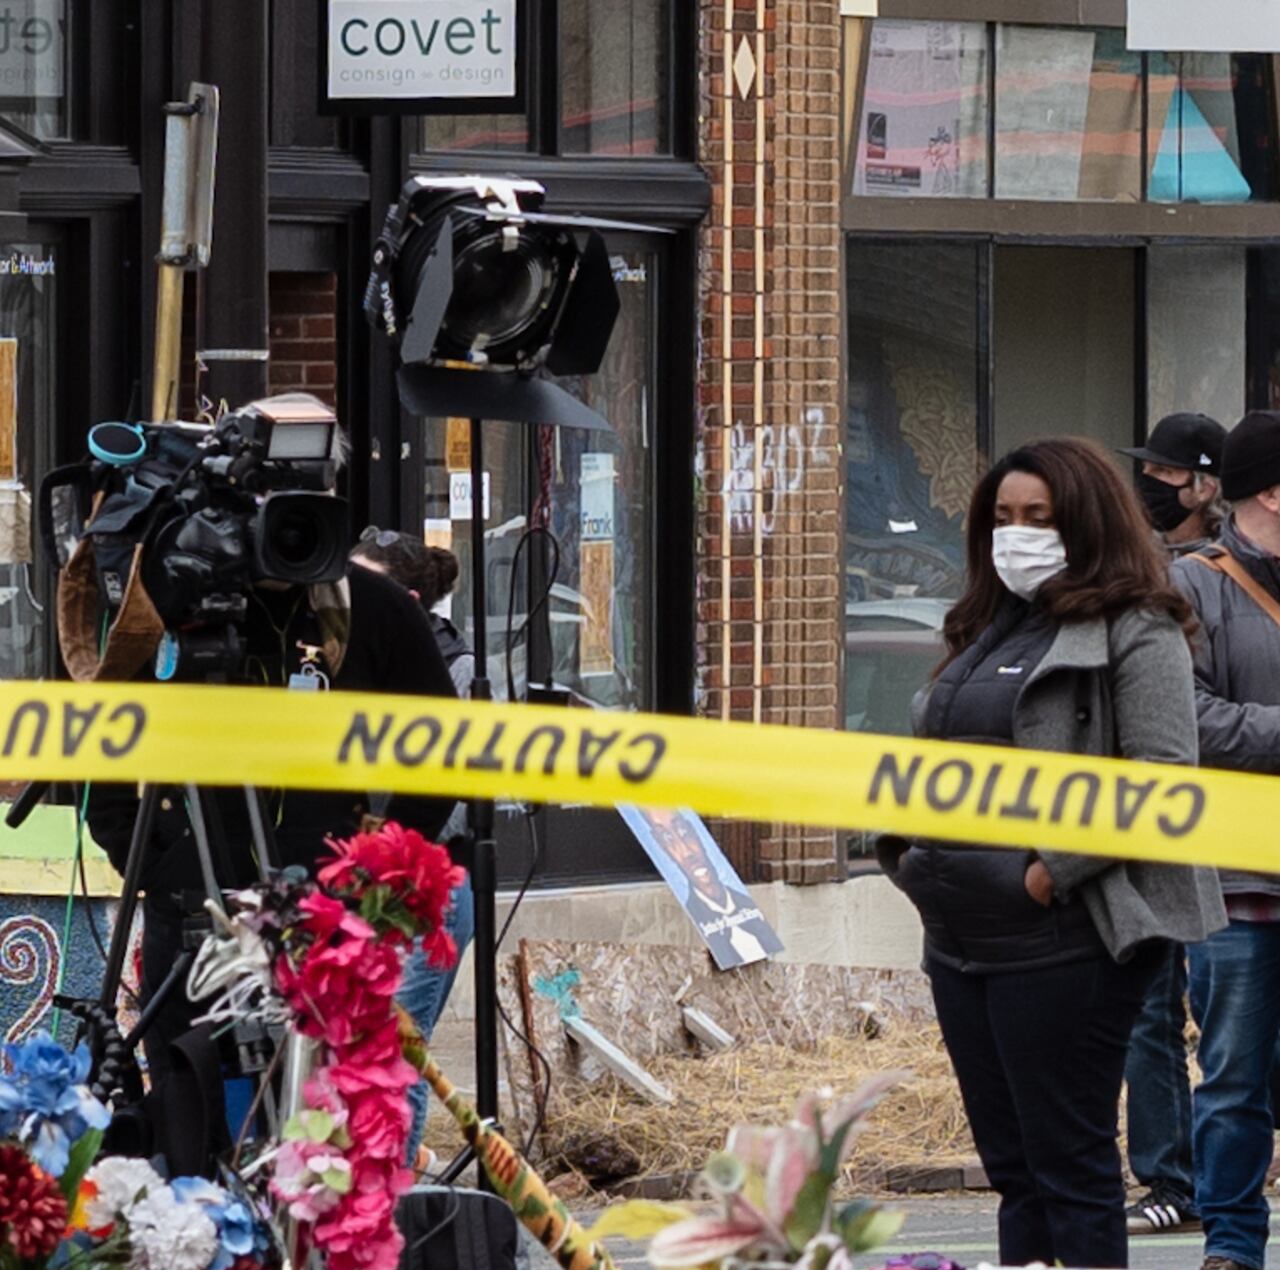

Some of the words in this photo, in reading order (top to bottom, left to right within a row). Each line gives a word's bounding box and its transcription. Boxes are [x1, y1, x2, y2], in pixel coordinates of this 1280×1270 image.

[340, 8, 503, 56] covet
[339, 67, 415, 86] consign
[438, 64, 504, 85] design
[336, 710, 668, 784] CAUTION
[866, 751, 1207, 838] CAUTION
